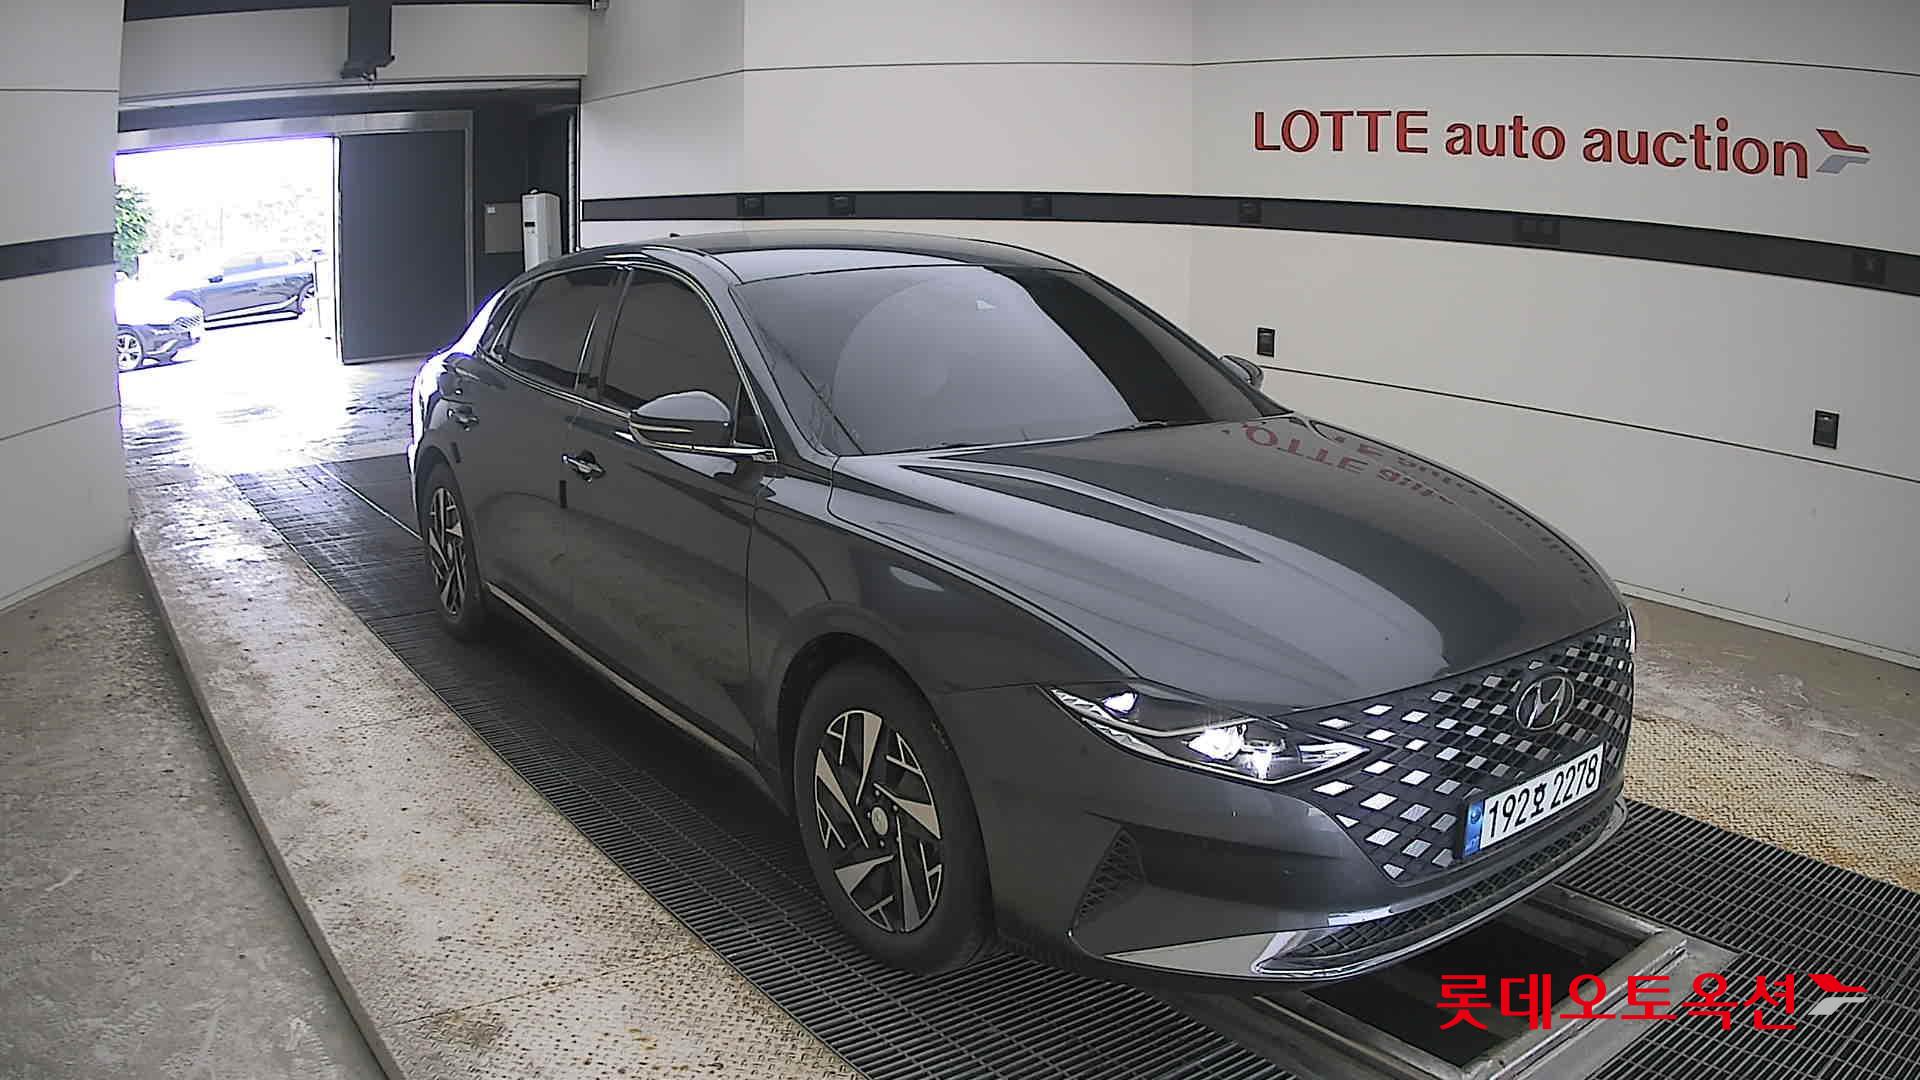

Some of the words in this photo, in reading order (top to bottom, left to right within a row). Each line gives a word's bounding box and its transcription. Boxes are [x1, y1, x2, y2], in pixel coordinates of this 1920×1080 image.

[1254, 109, 1429, 154] LOTTE
[1444, 114, 1566, 160] auto
[1582, 117, 1809, 178] auction
[1488, 782, 1548, 838] 192호
[1551, 753, 1599, 809] 2278
